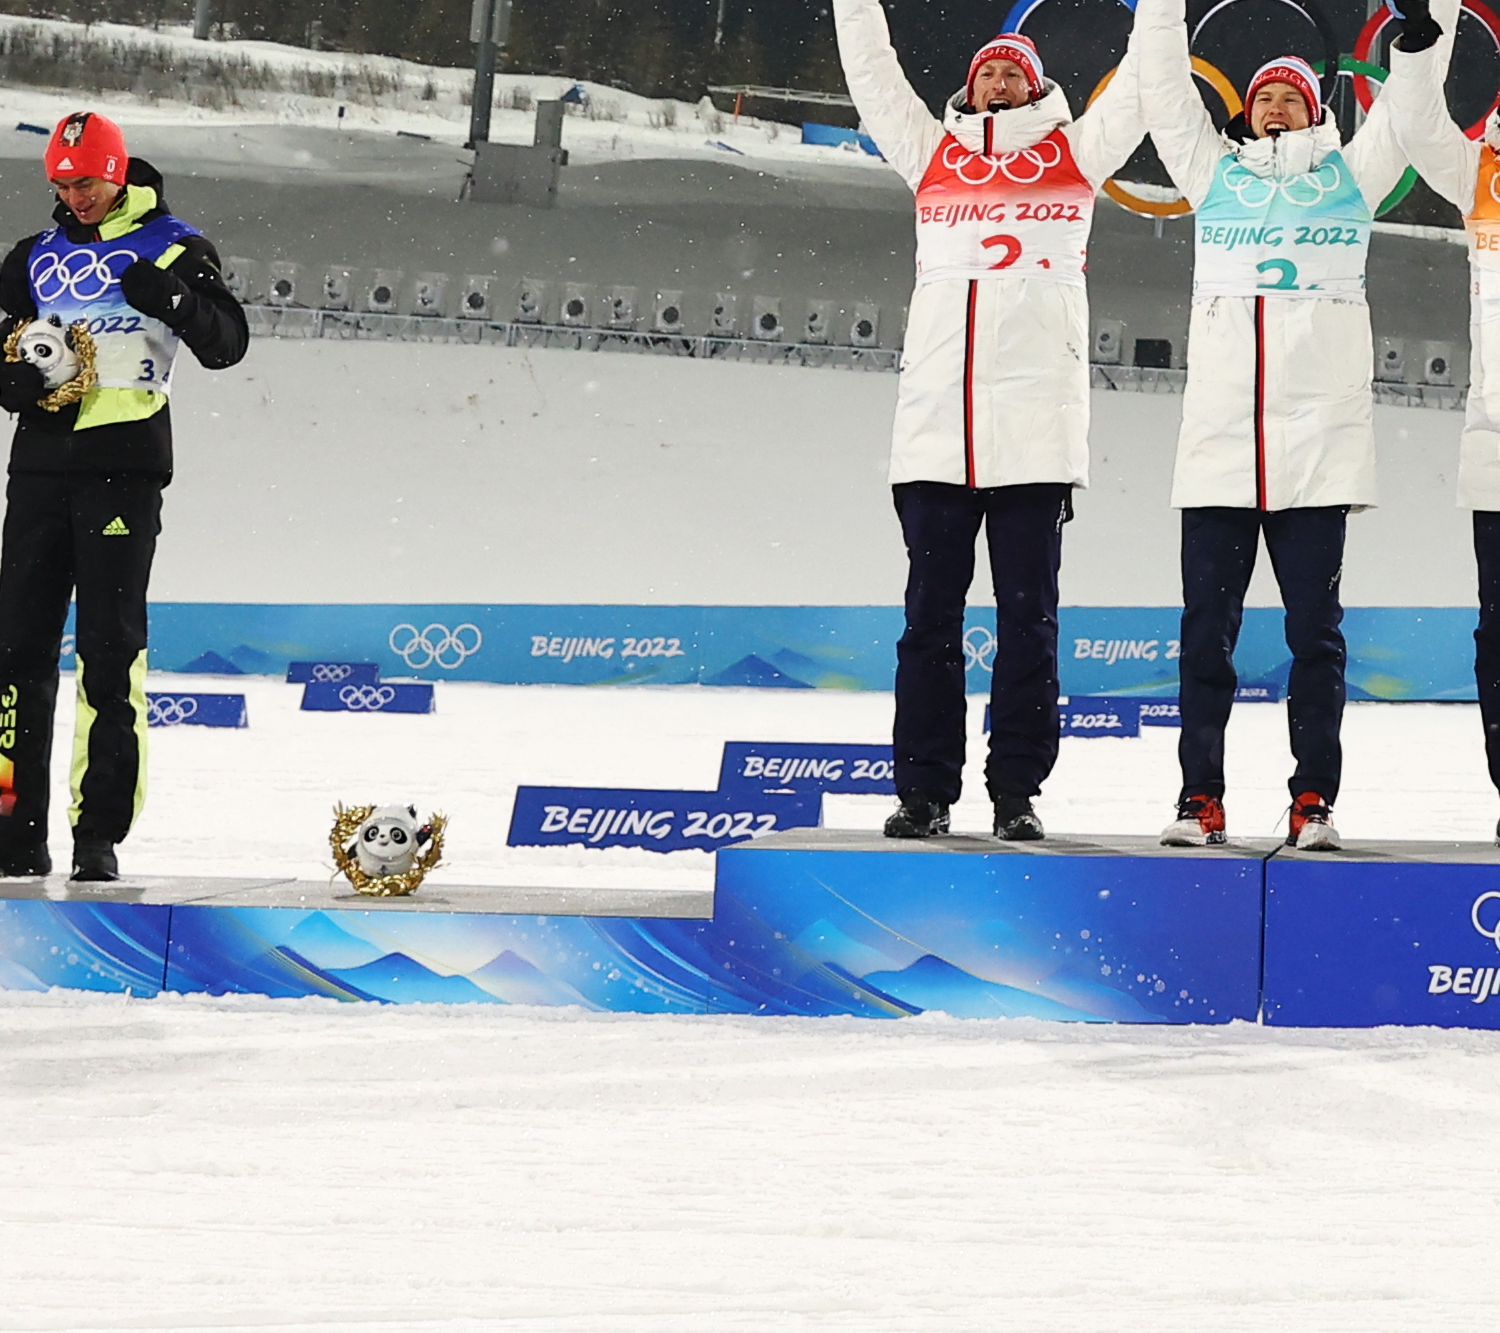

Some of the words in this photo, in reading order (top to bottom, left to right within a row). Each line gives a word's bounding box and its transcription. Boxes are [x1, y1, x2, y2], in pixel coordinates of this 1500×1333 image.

[920, 203, 1006, 228] BEIJING
[1016, 202, 1085, 223] 2022
[1201, 226, 1284, 251] BEIJING
[1295, 226, 1363, 247] 2022
[1256, 258, 1300, 291] 2
[139, 359, 156, 383] 3
[530, 635, 616, 664] BEIJING
[620, 637, 686, 658] 2022
[1073, 638, 1159, 666] BEIJING
[1070, 714, 1122, 729] 2022
[743, 756, 845, 784] BEIJING
[541, 806, 674, 843] BEIJING
[686, 813, 777, 840] 2022
